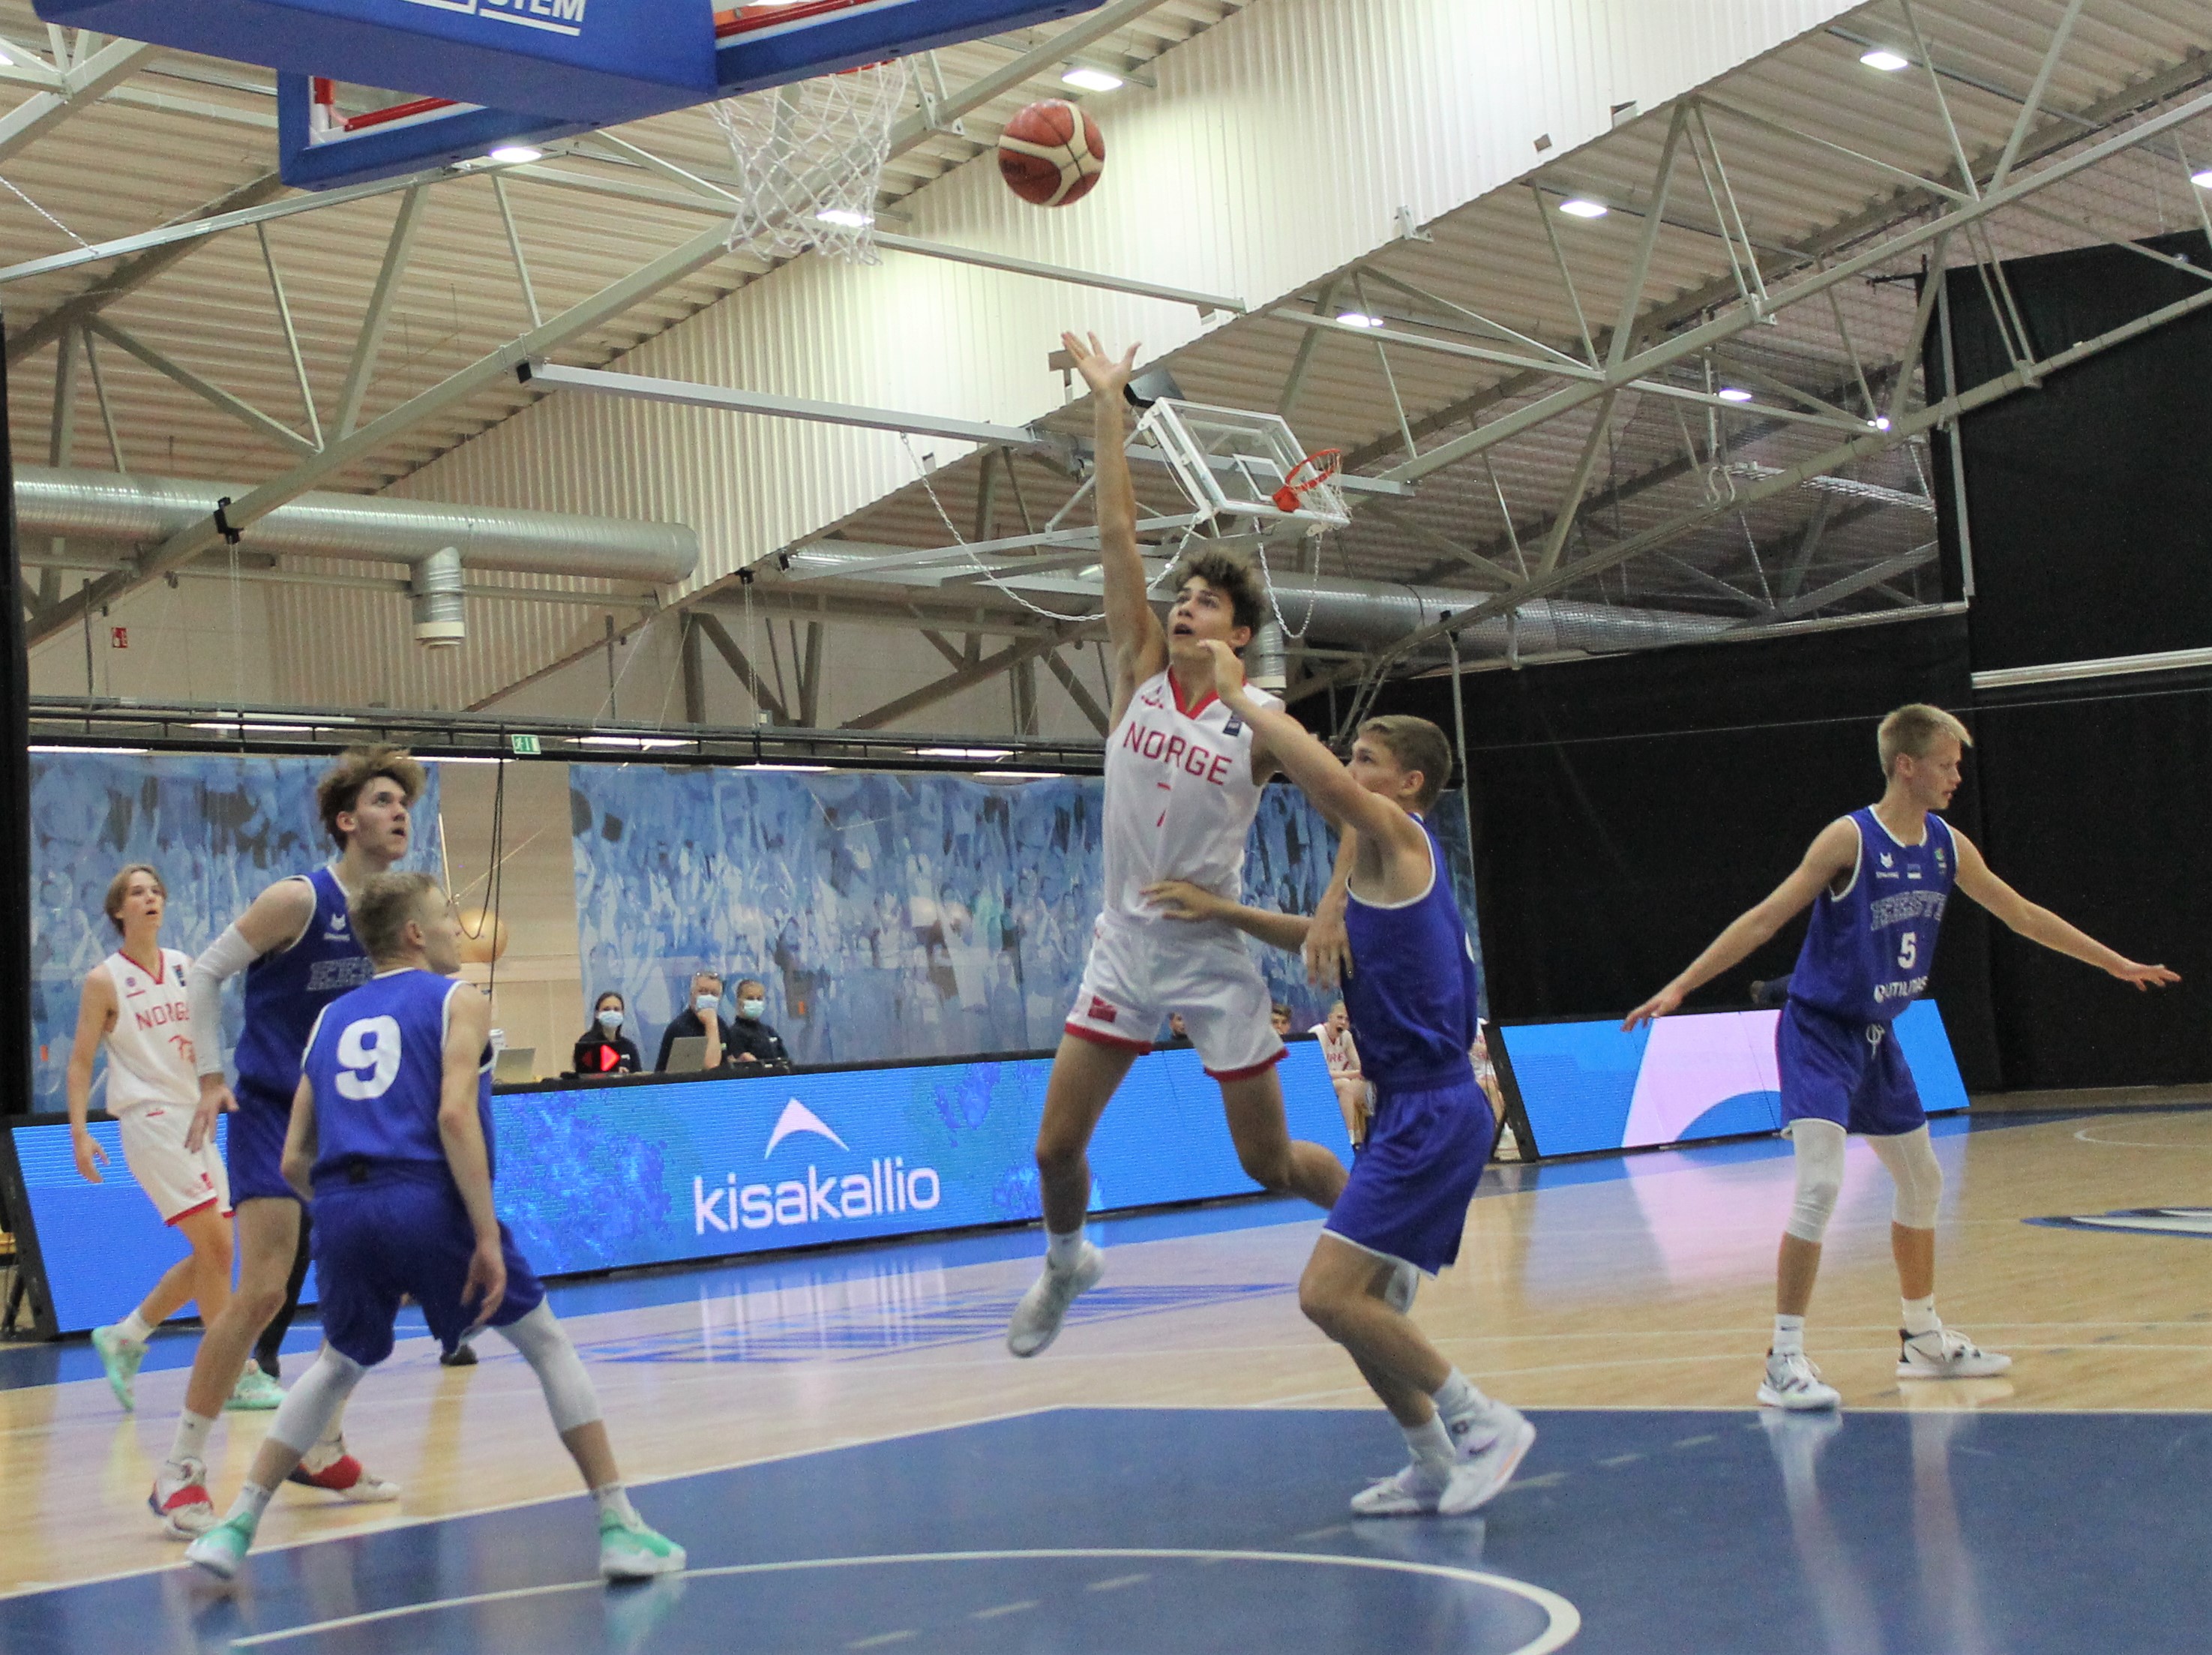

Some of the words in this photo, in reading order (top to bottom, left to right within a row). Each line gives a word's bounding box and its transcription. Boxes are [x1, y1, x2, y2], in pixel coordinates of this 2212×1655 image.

[1123, 721, 1233, 786] NORGE
[1897, 931, 1917, 970] 5
[334, 1015, 402, 1101] 9
[694, 1156, 941, 1235] kisakallio
